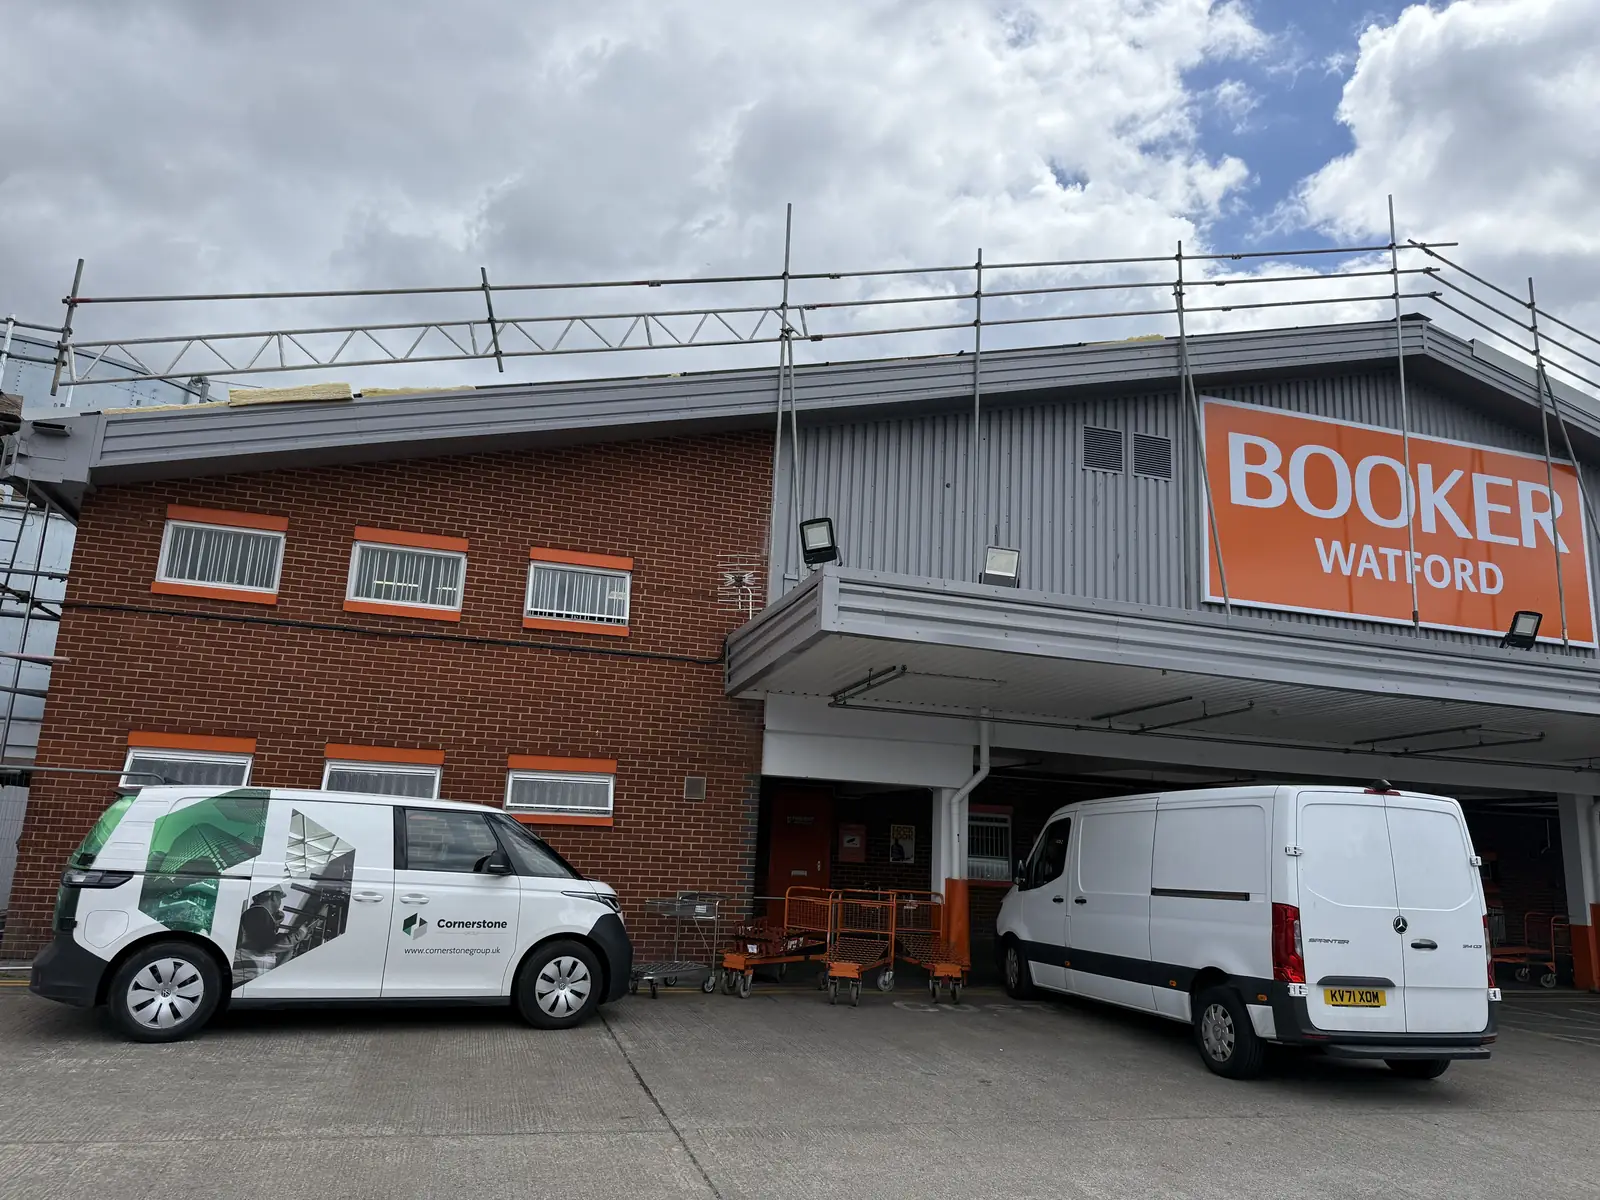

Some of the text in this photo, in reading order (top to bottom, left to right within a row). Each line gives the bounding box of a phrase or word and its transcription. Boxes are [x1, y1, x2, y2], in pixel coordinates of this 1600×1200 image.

[1228, 431, 1570, 553] BOOKER
[1314, 537, 1504, 595] WATFORD
[437, 919, 508, 929] Cornerstone
[404, 947, 501, 956] www.cornerstonegroup.uk
[1330, 989, 1380, 1004] KV71 XOM
